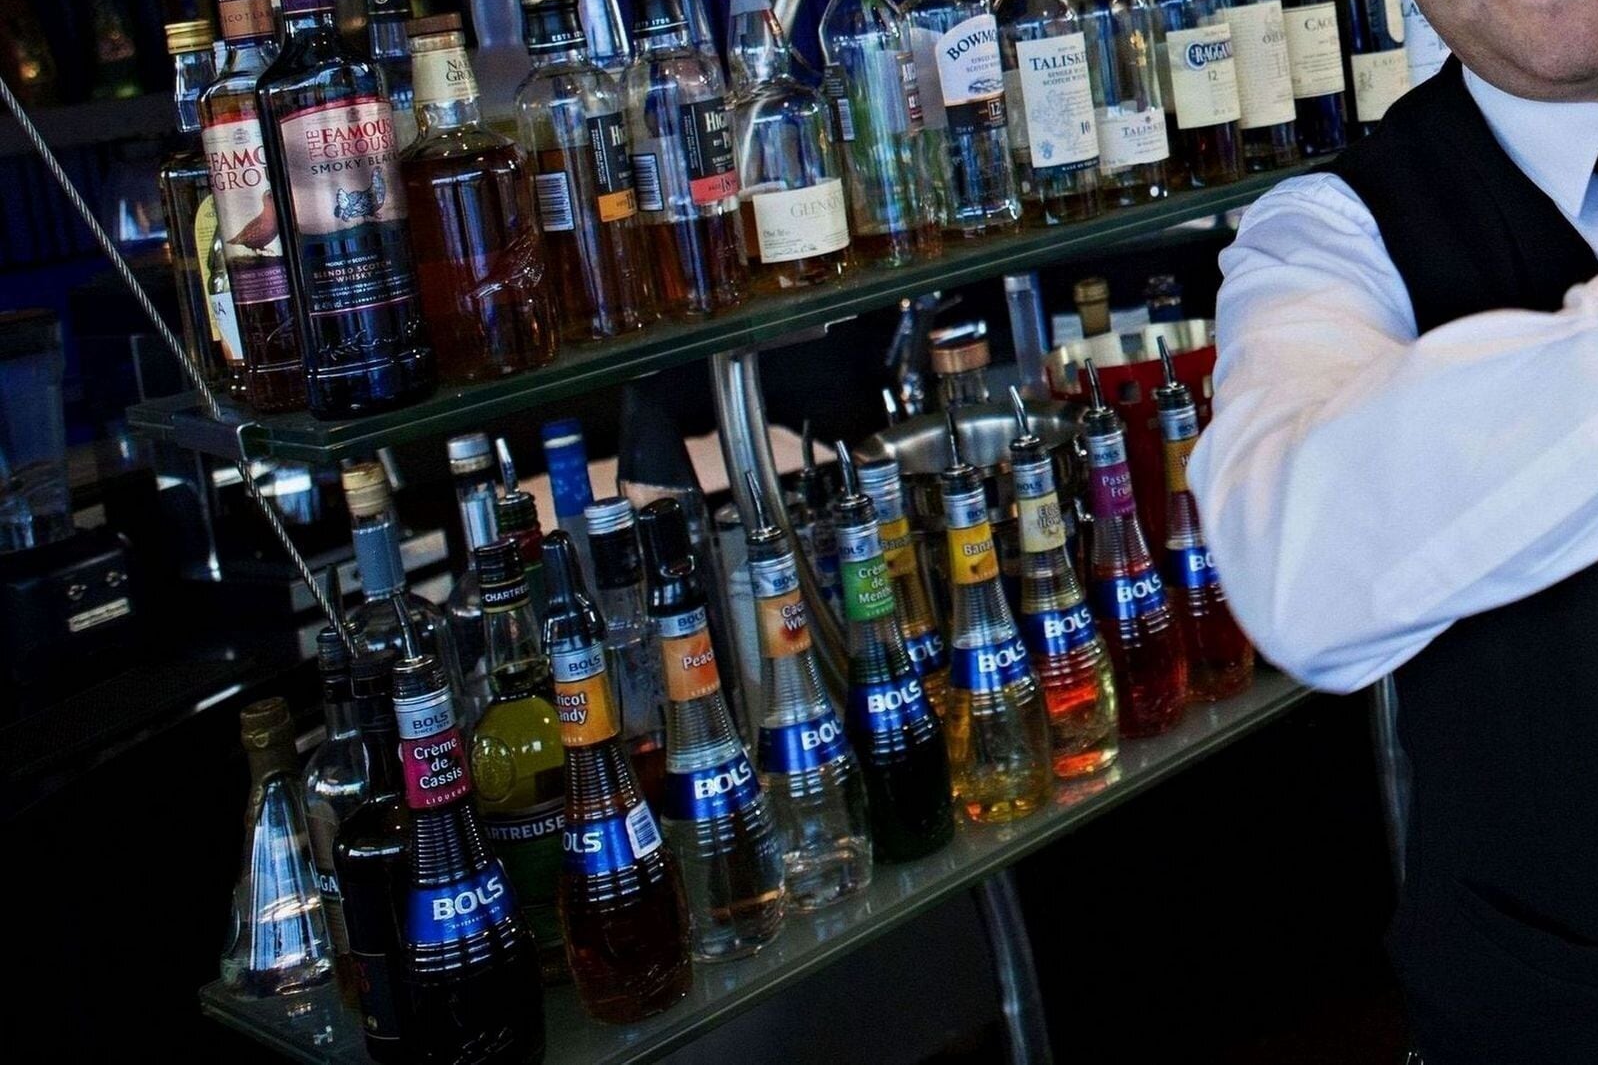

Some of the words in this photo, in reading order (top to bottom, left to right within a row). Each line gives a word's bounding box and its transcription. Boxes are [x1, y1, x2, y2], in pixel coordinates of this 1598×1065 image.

[1207, 70, 1218, 82] 12
[989, 101, 1002, 117] 12
[323, 118, 392, 145] FAMOUS
[1081, 120, 1091, 136] 10
[306, 129, 322, 161] THE
[311, 158, 363, 175] SMOKY
[357, 259, 393, 273] SCOTCH
[336, 271, 372, 283] WHISKY
[870, 577, 884, 591] de
[1116, 573, 1163, 604] BOLS
[1043, 607, 1093, 639] BOLS
[568, 653, 602, 674] BOLS
[976, 639, 1028, 674] BOLS
[867, 681, 922, 714] BOLS
[412, 710, 450, 731] BOLS
[413, 738, 459, 761] Crème
[429, 757, 450, 773] de
[419, 769, 464, 791] Cassis
[694, 760, 752, 800] BOLS
[432, 876, 506, 921] BOLS
